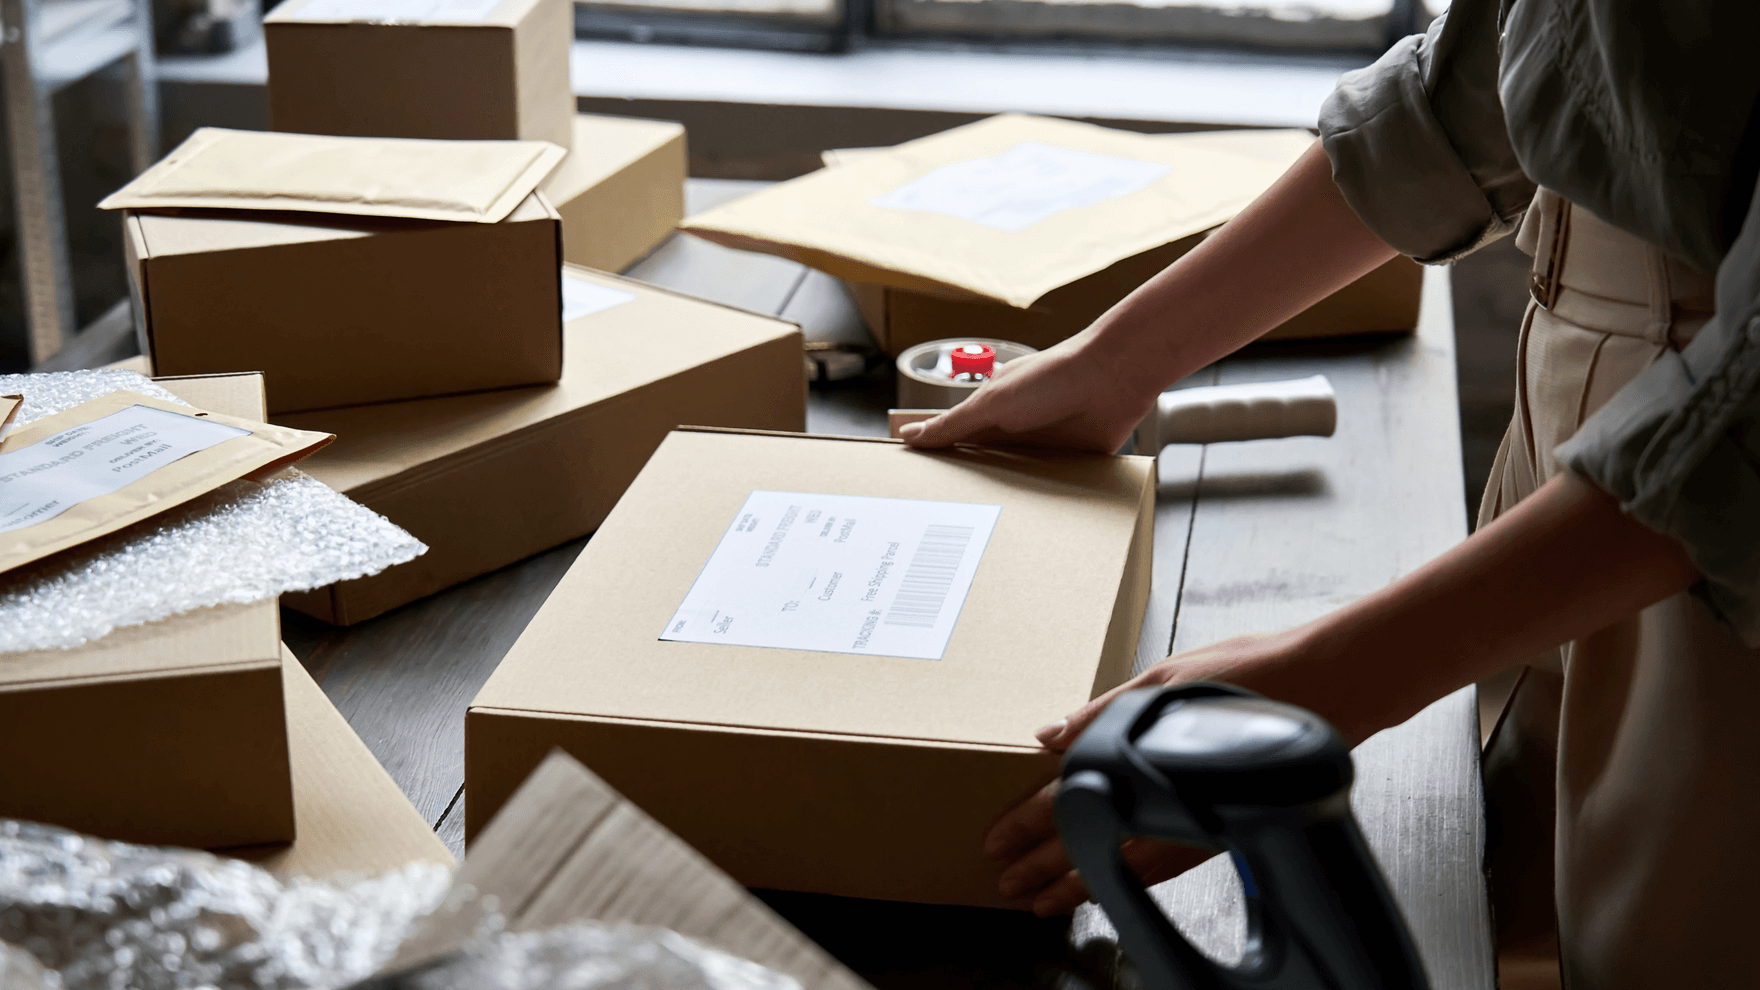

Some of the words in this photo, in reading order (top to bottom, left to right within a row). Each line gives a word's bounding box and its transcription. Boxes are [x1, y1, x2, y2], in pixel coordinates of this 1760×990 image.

[119, 431, 158, 446] WED
[0, 450, 85, 483] STANDARD
[83, 423, 148, 451] FREIGHT
[111, 443, 173, 473] PostMail
[803, 509, 822, 524] WED
[755, 531, 787, 567] STANDARD
[776, 504, 803, 531] FREIGHT
[833, 518, 857, 543] PostMail
[880, 541, 900, 560] Parcel
[818, 571, 843, 601] Customer
[868, 561, 895, 587] Shipping
[781, 600, 801, 612] TO:
[860, 588, 879, 602] Free
[713, 616, 735, 634] Seller
[852, 616, 879, 649] TRACKING
